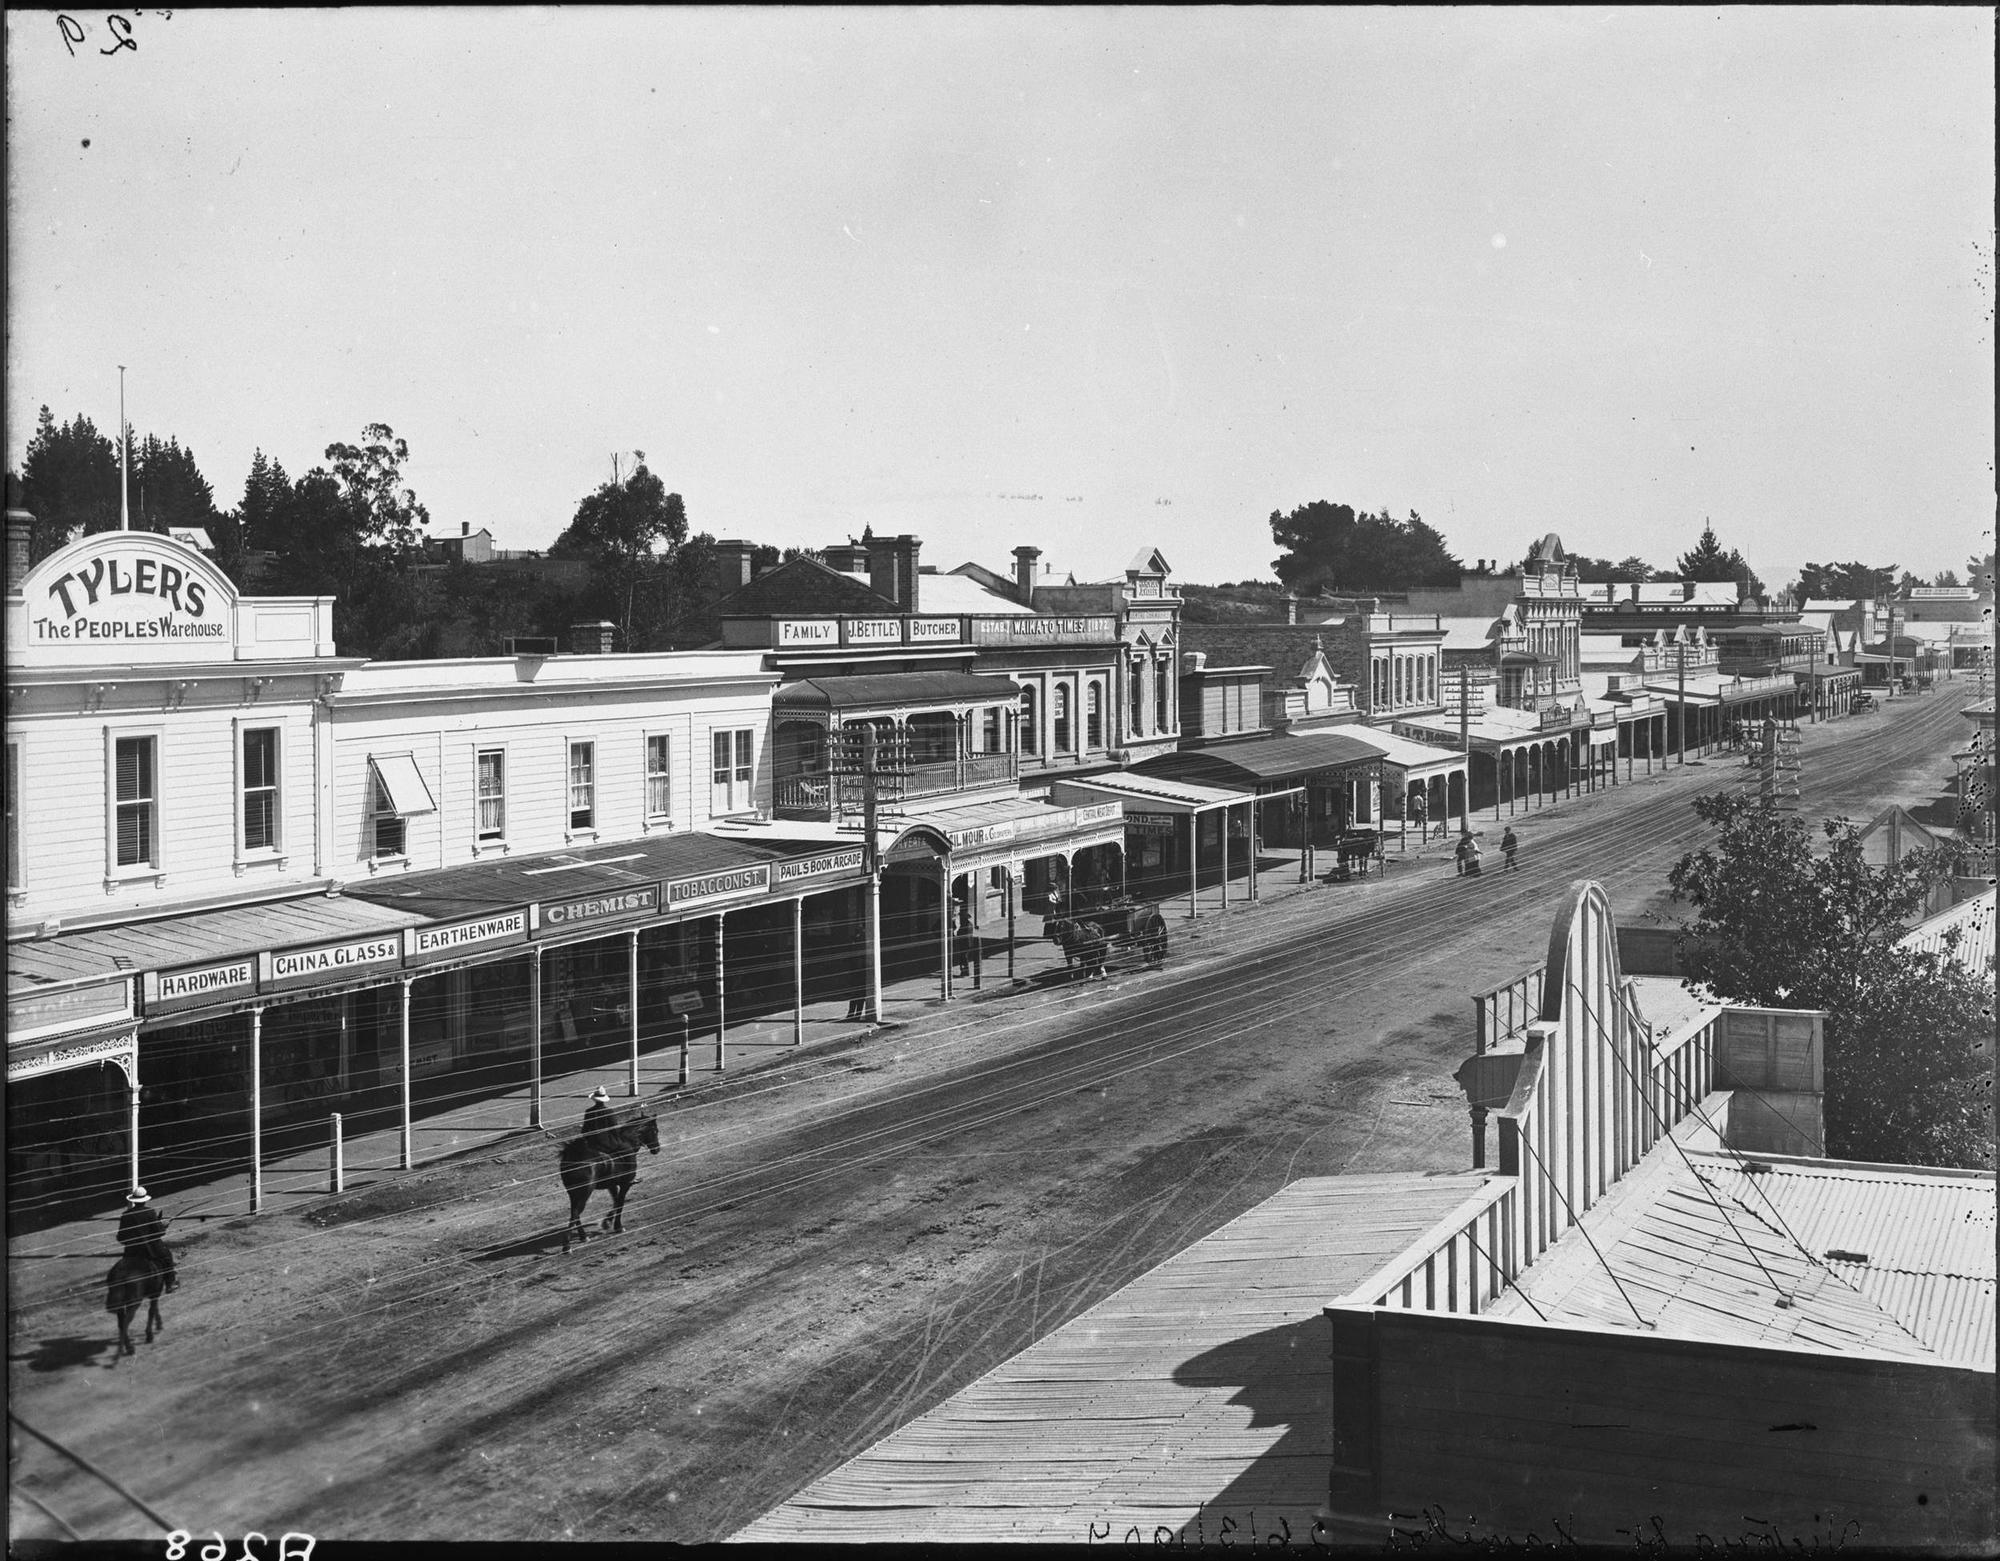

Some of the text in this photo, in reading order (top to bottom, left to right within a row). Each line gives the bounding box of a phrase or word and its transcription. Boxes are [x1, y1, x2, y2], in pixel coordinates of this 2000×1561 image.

[49, 557, 206, 620] TYLER'S
[33, 617, 71, 639] The
[74, 618, 158, 639] PEOPLE'S
[783, 623, 830, 639] FAMILY
[1013, 618, 1054, 635] WAIKATO
[780, 852, 862, 879] PAUL'S BOOK ARCADE
[334, 943, 386, 965] GLASS
[387, 943, 395, 956] &
